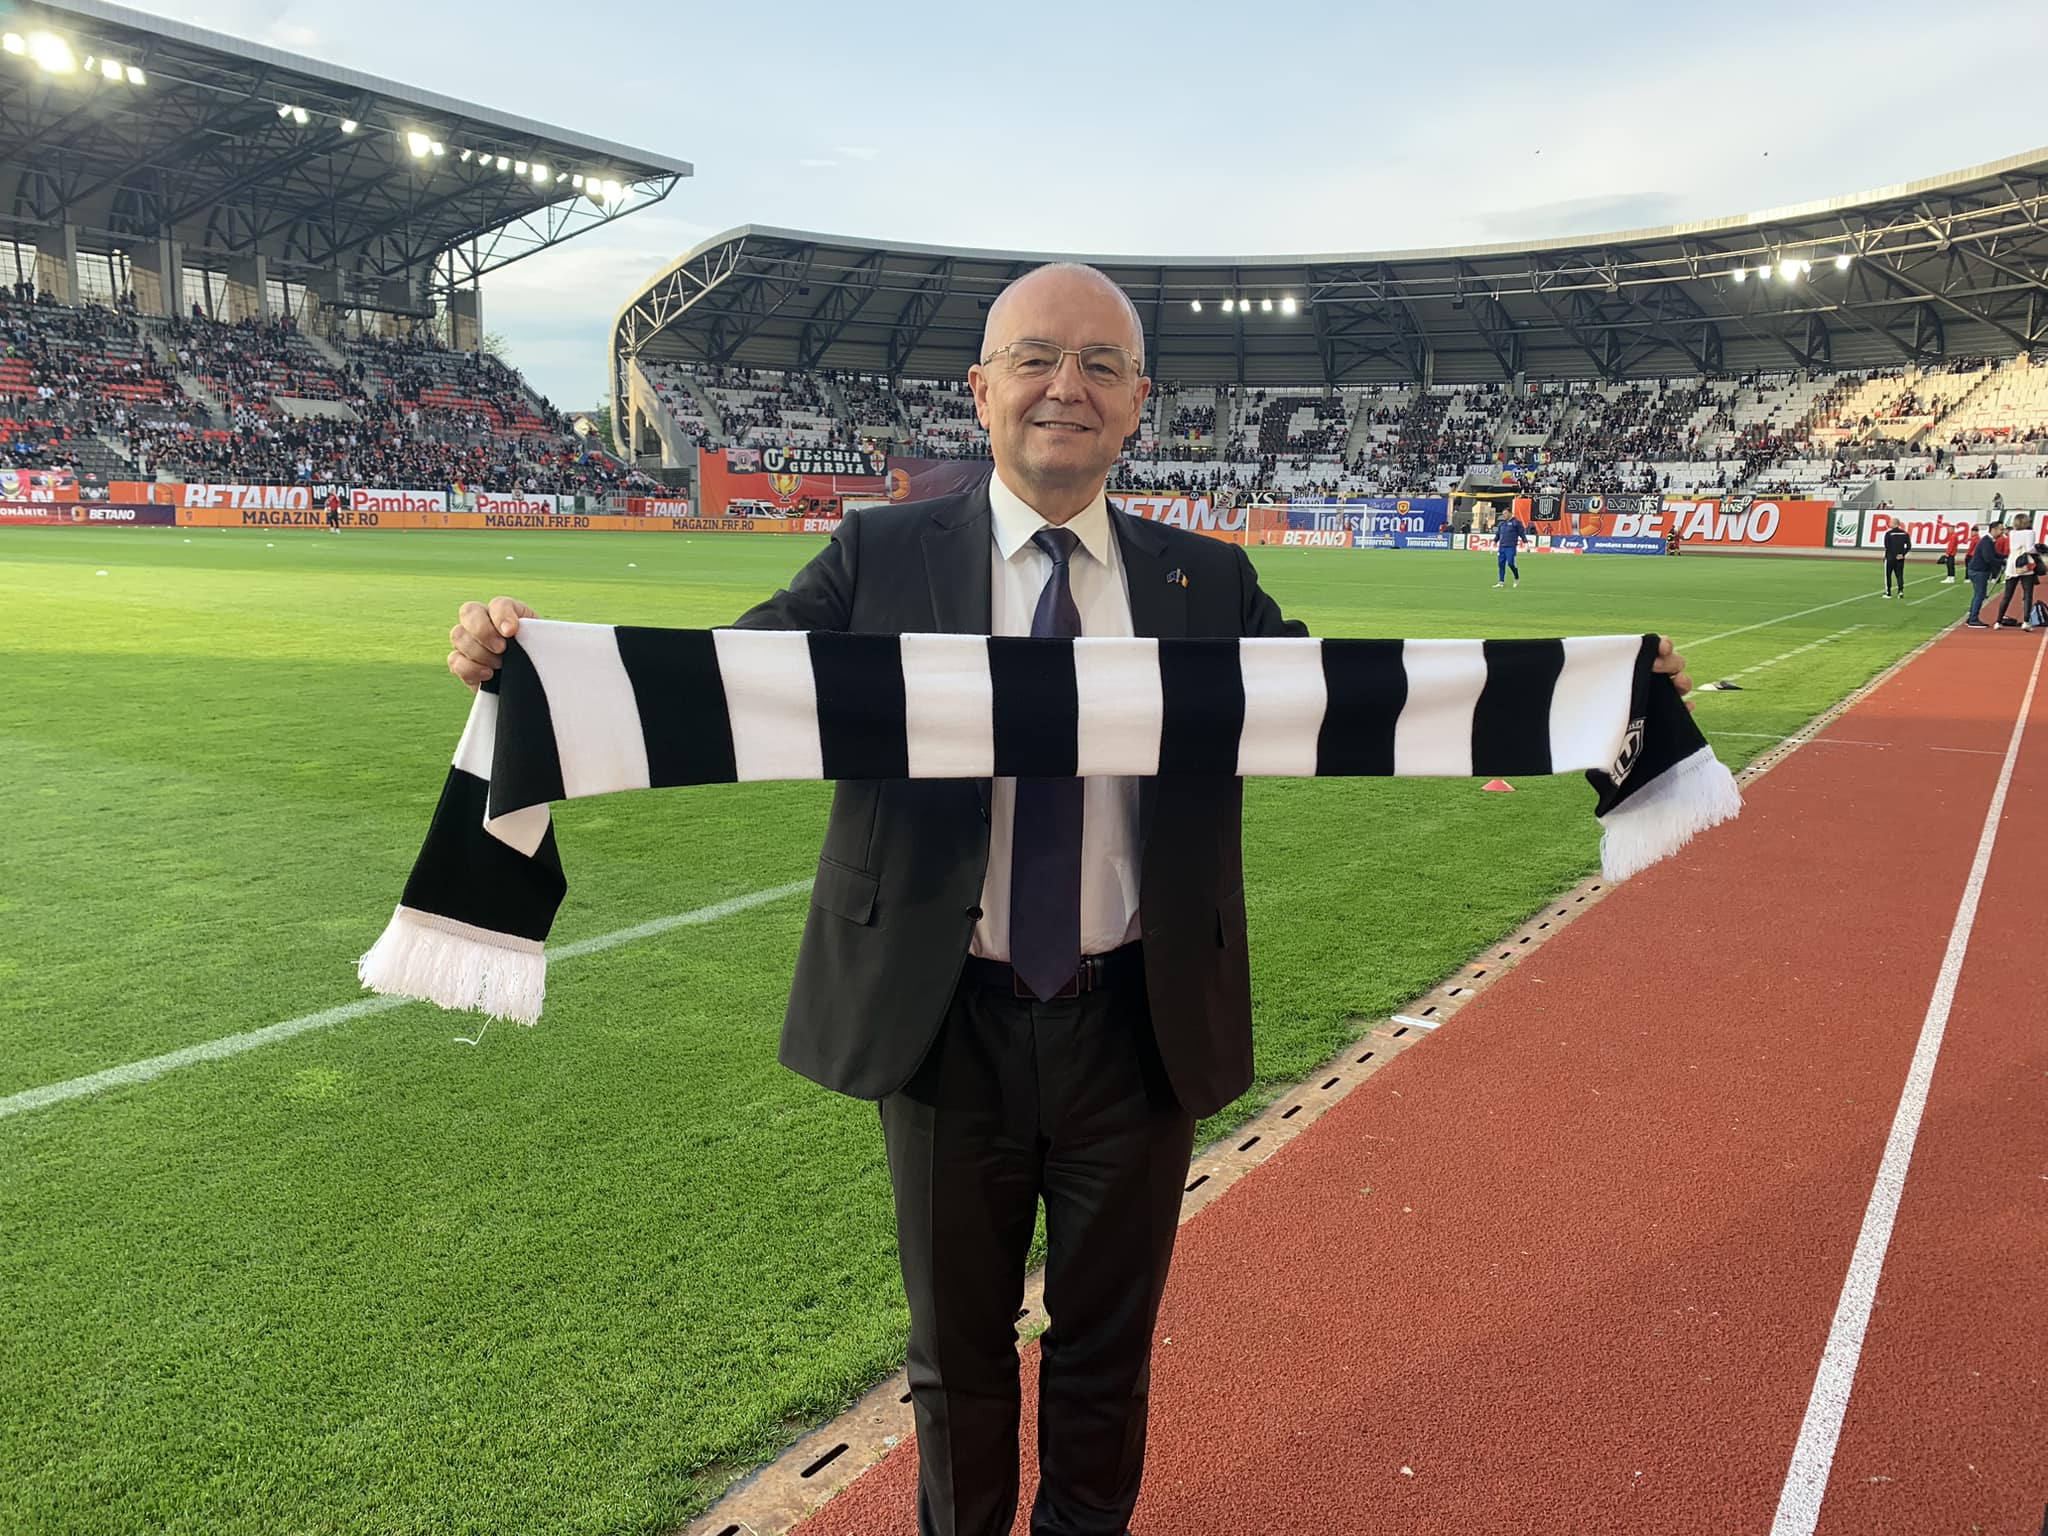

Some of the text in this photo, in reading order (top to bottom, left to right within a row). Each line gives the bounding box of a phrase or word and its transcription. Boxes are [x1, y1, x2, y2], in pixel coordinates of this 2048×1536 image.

[789, 462, 865, 474] GUARDIA
[184, 484, 308, 509] BETANO
[352, 491, 440, 513] Pambac
[476, 494, 549, 514] Pamba
[89, 509, 136, 520] BETANO
[485, 515, 590, 528] MAGAZIN.FRF.RO
[1612, 501, 1780, 542] BETANO
[672, 518, 754, 531] MAGAZIN.FRF.RO
[804, 518, 841, 532] BETAN
[1869, 513, 1975, 545] Pmba
[1283, 530, 1346, 545] BETANO
